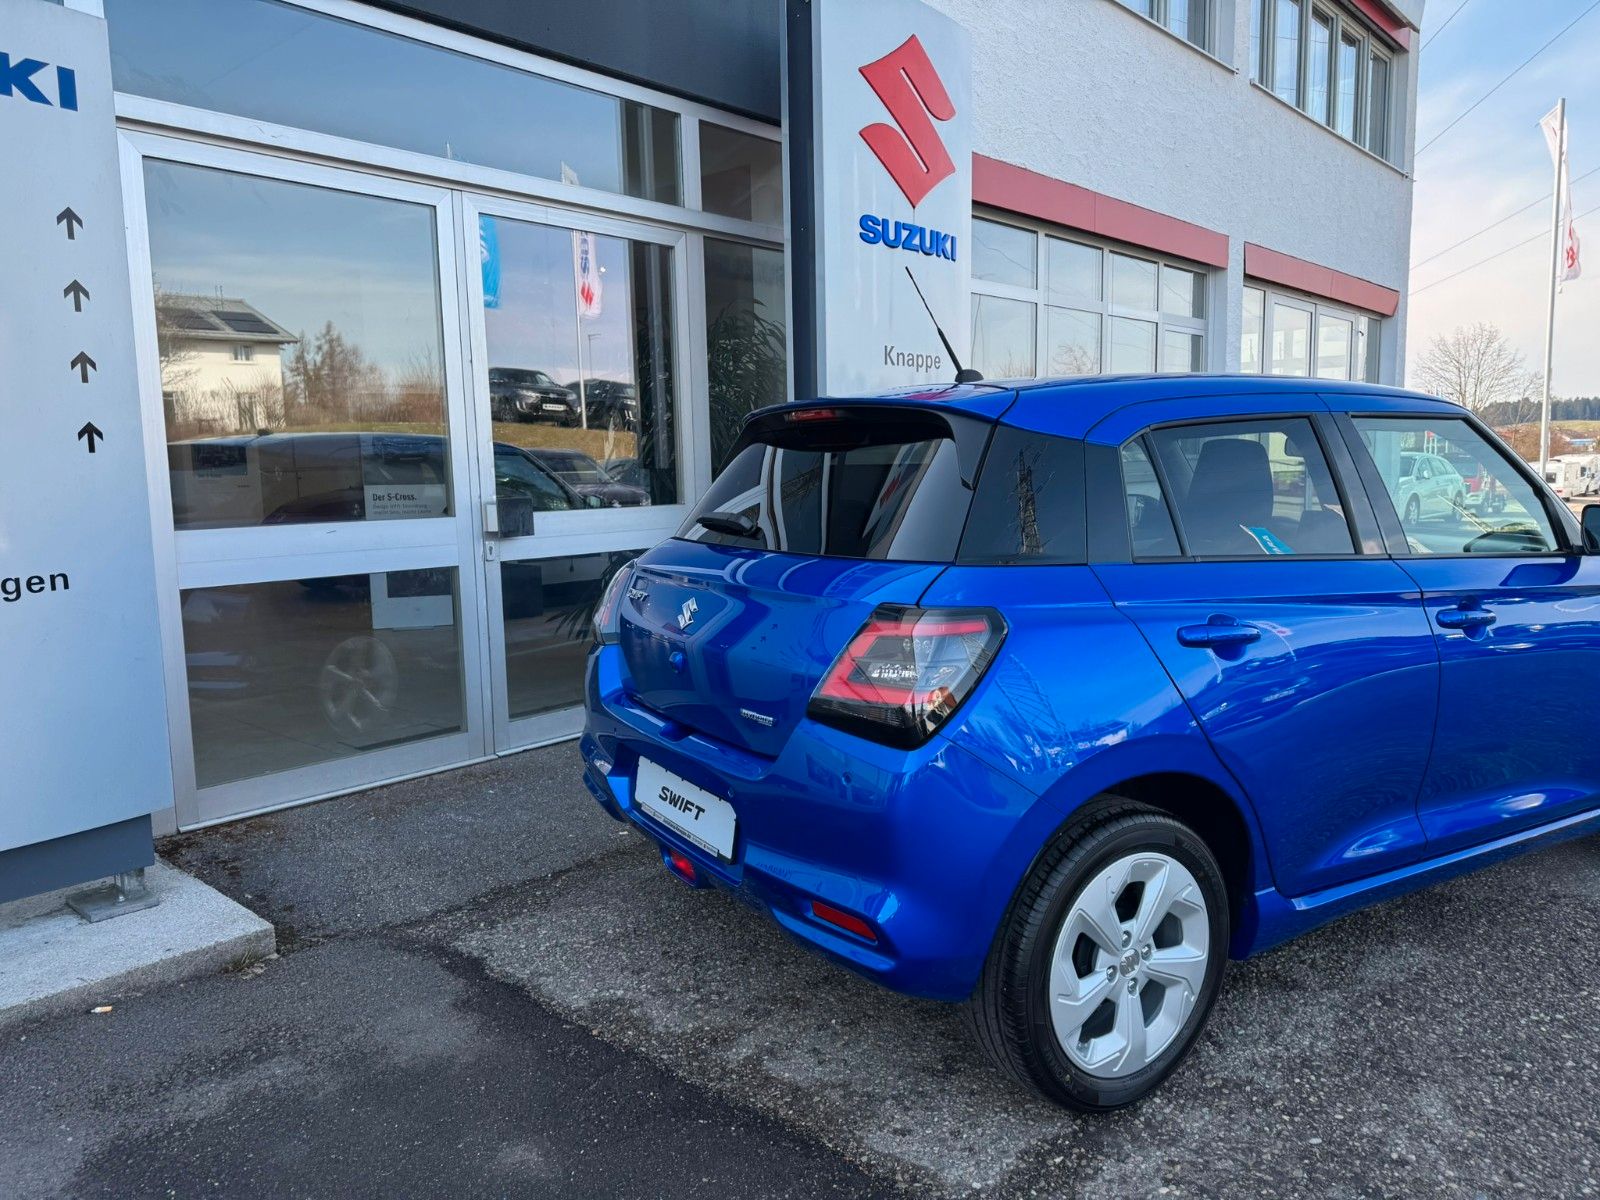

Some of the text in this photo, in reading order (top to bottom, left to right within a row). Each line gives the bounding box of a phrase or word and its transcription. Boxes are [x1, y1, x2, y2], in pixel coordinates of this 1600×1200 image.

[0, 51, 78, 112] KI
[859, 214, 957, 262] SUZUKI
[884, 345, 941, 373] Knappe
[372, 493, 385, 501] Der
[0, 572, 70, 603] gen
[658, 785, 706, 821] SWIFT
